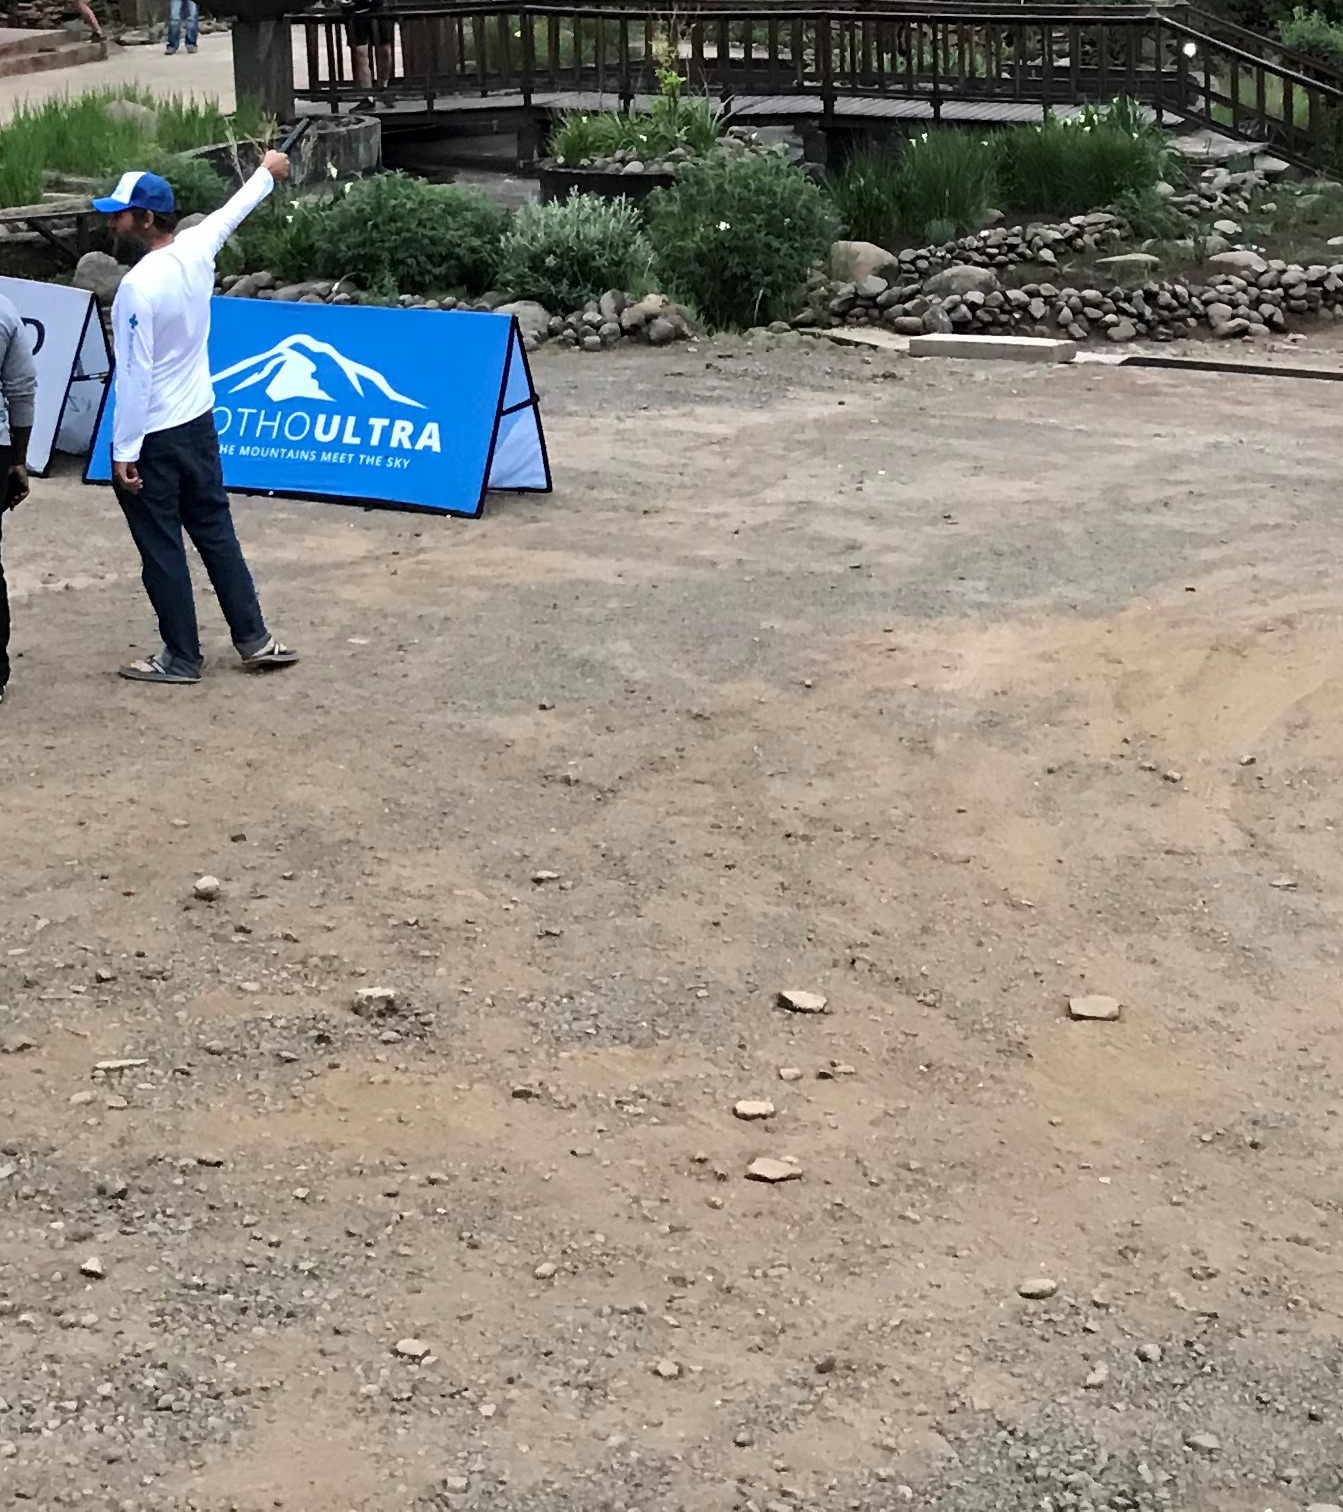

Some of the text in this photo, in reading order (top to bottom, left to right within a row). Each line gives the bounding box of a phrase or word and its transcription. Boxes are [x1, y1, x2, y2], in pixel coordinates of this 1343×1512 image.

[218, 444, 411, 469] HE MOUNTAINS MEET THE SKY
